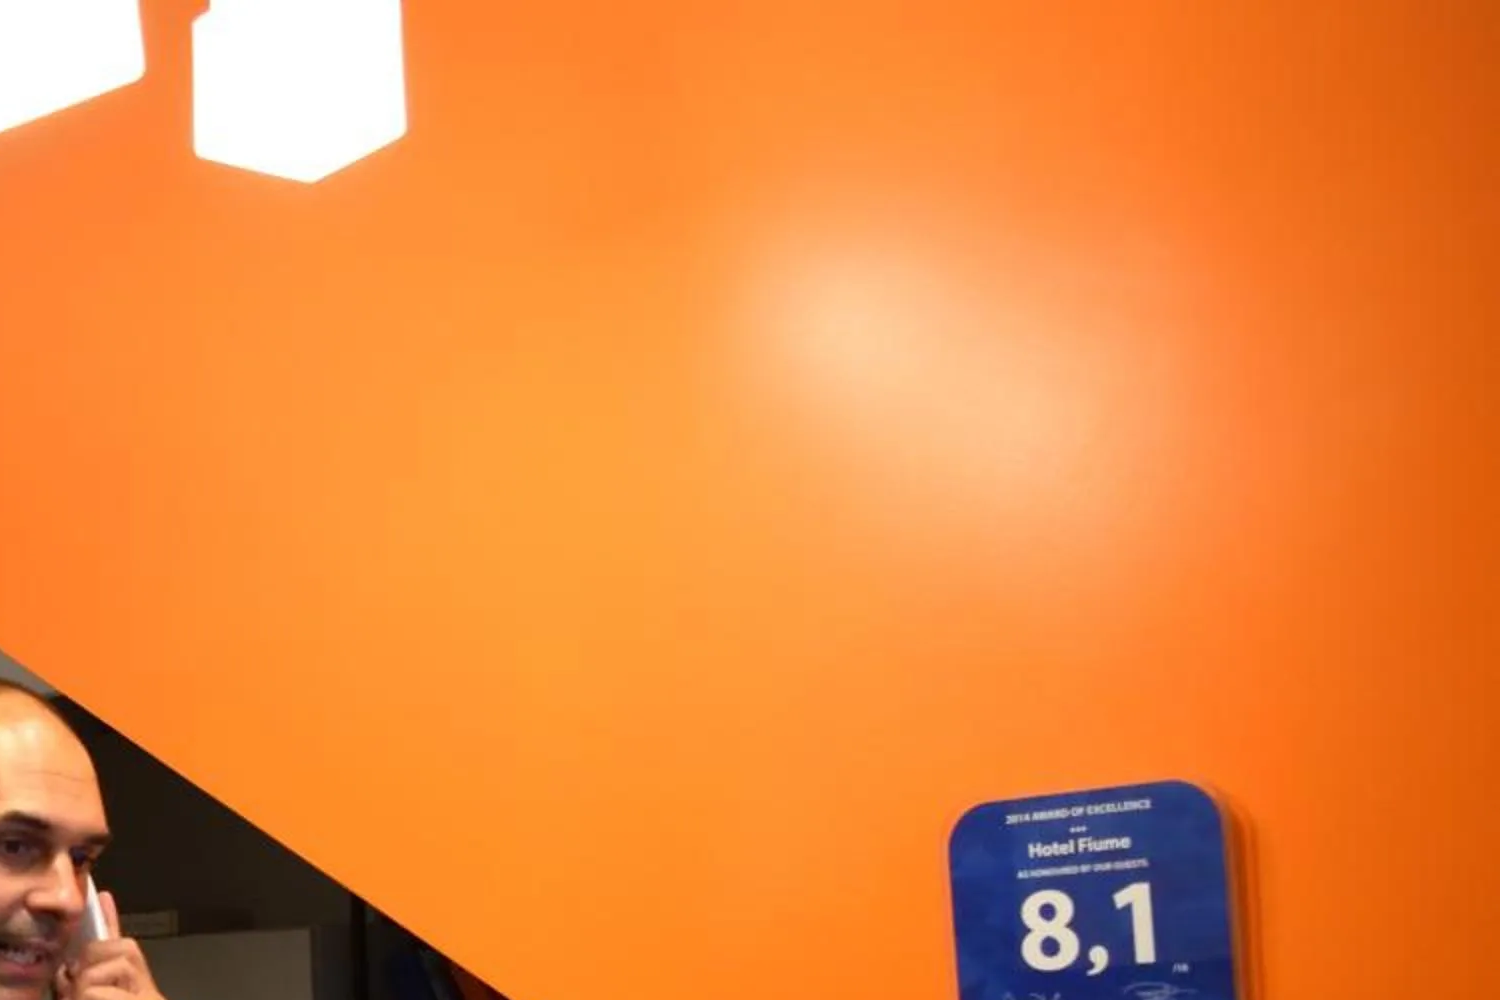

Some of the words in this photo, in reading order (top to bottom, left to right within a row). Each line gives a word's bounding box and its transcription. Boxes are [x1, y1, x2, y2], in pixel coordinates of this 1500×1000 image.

[1070, 806, 1085, 817] OF
[1086, 799, 1152, 815] EXCELLENCE
[1027, 839, 1075, 859] Hotel
[1077, 836, 1132, 853] Fiume
[1020, 881, 1157, 976] 8,1
